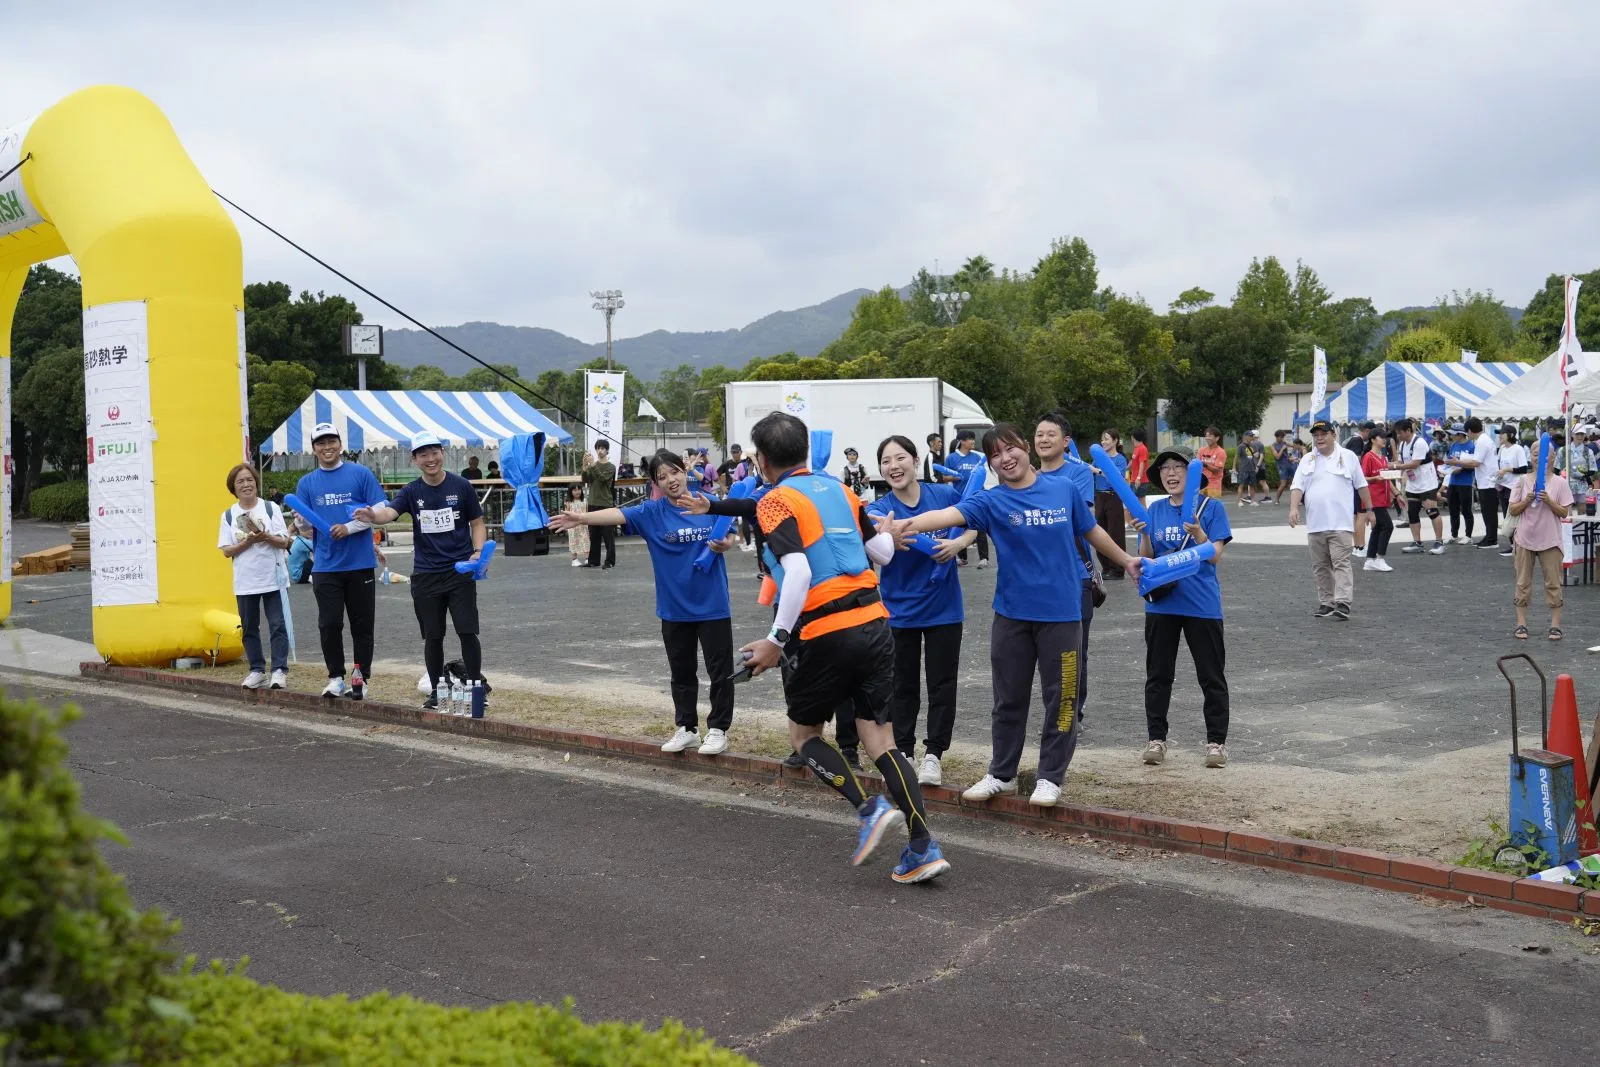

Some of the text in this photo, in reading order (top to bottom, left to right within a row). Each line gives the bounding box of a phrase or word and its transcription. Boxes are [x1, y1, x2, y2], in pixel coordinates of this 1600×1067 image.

[107, 442, 137, 455] FUJI
[434, 514, 451, 525] 515
[1025, 516, 1054, 526] 2026
[679, 533, 703, 543] 2026
[1539, 768, 1553, 831] EVERNEW
